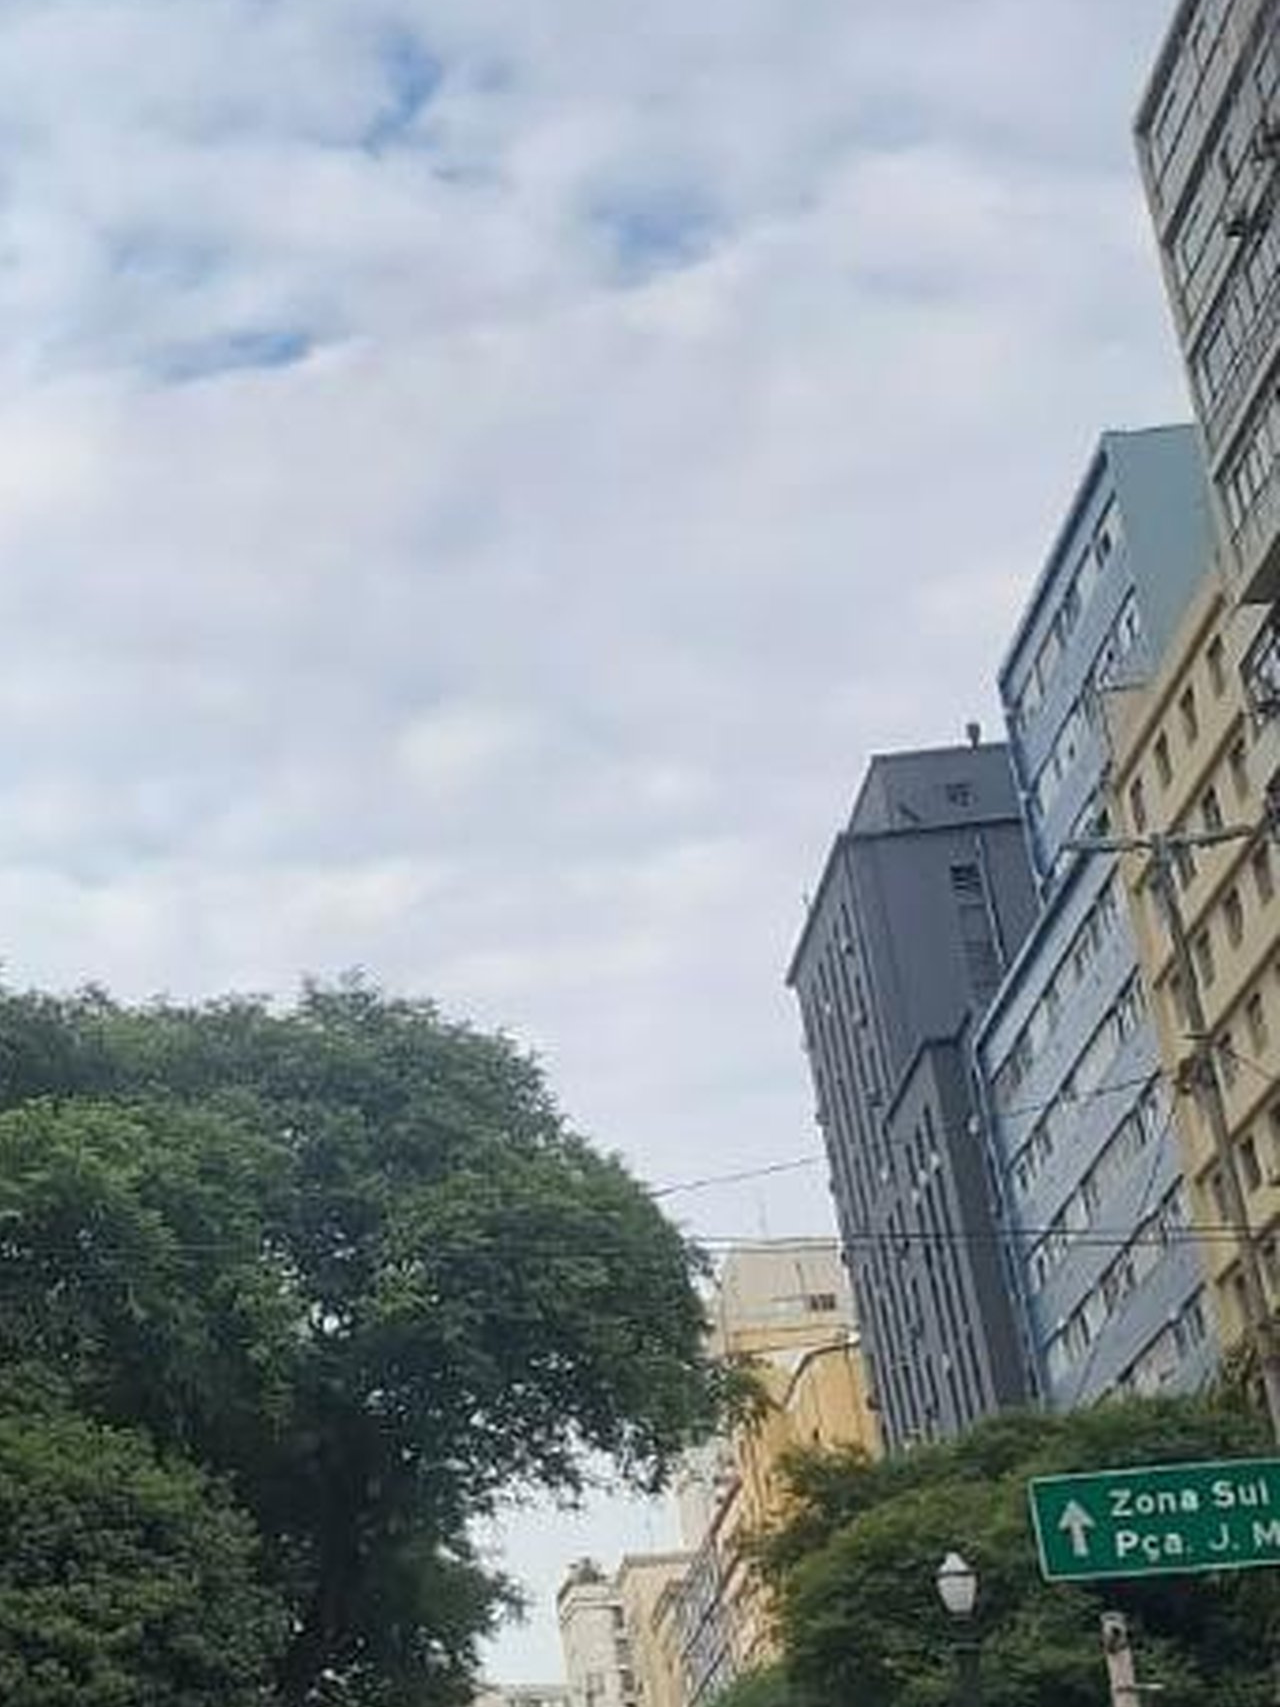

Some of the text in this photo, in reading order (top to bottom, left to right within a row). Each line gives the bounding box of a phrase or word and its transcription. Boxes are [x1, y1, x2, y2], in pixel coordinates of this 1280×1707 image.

[1108, 1478, 1270, 1518] Zona Sul
[1208, 1522, 1241, 1552] J.
